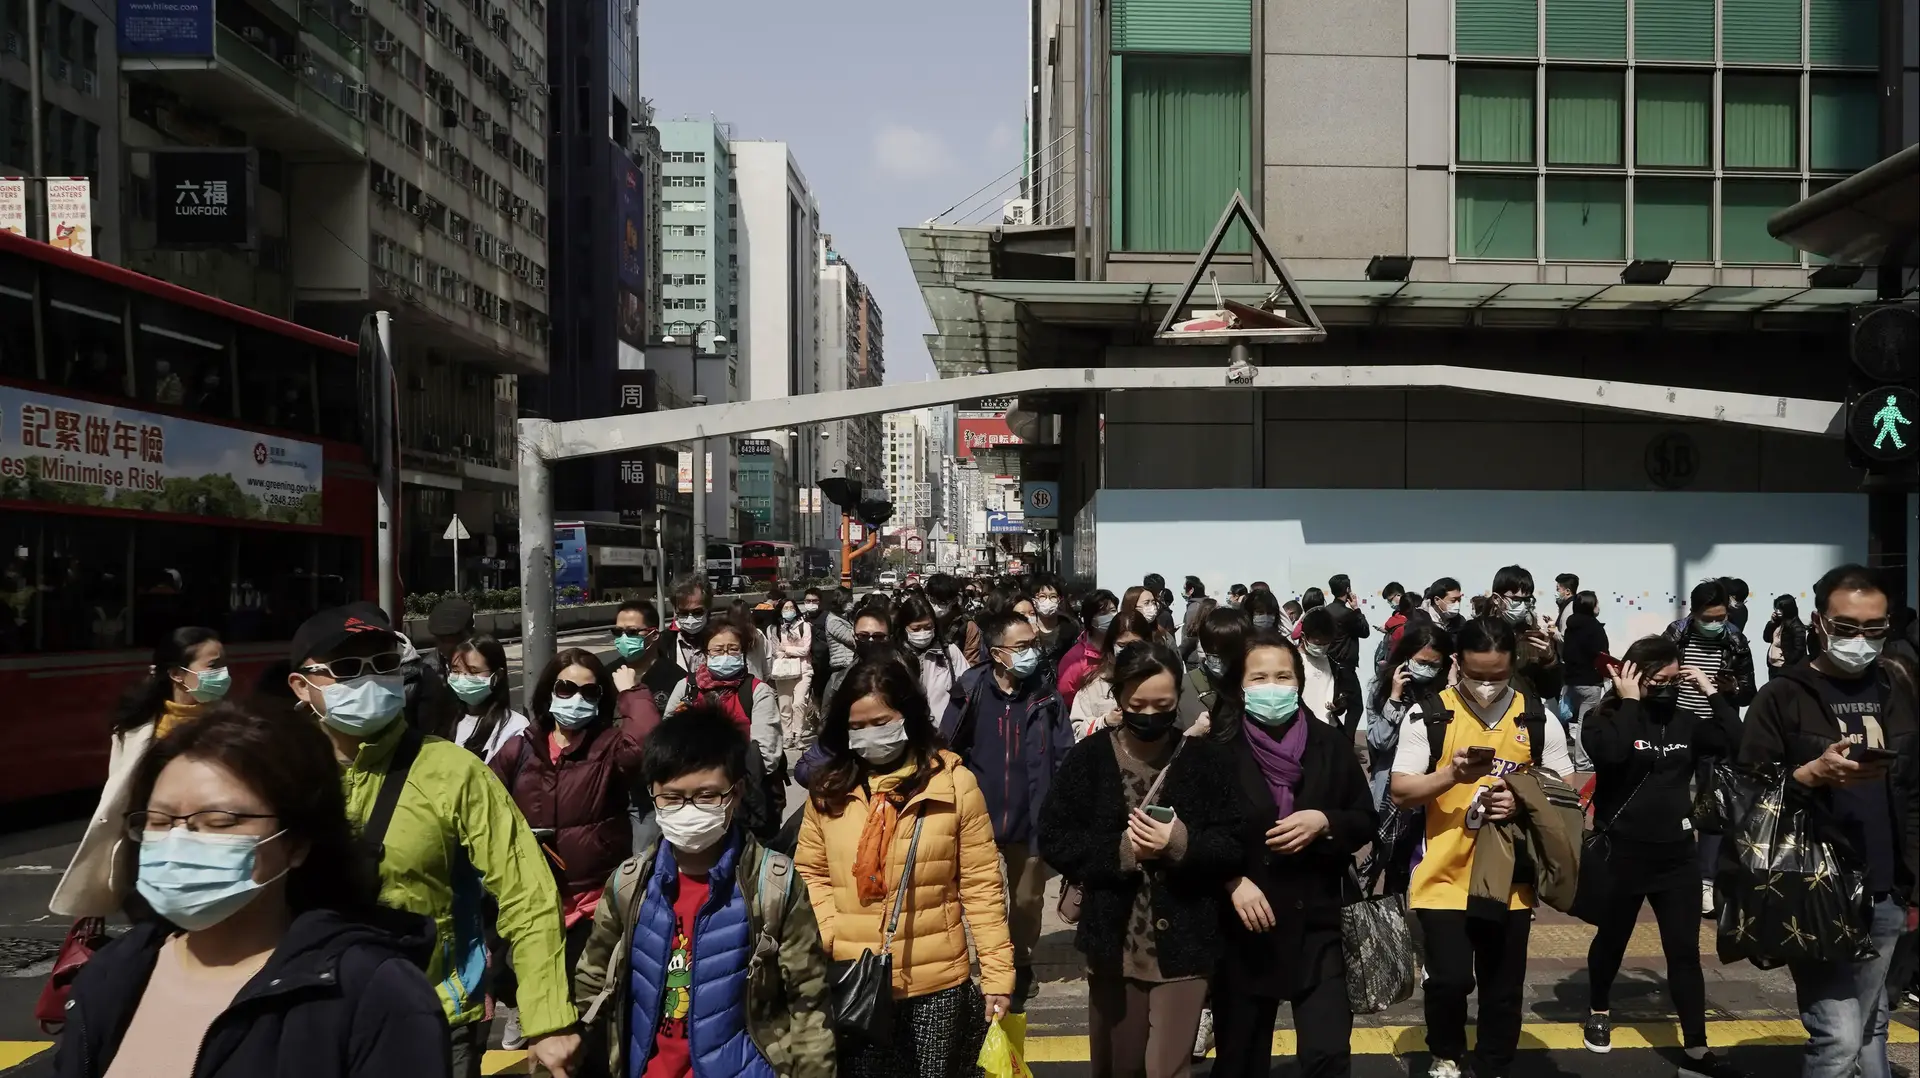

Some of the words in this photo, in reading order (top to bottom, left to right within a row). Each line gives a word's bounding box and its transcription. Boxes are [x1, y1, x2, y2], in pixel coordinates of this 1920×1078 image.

[176, 180, 228, 205] 六福
[175, 206, 227, 216] LUKFOOK
[22, 405, 164, 464] 記緊做年檢
[42, 455, 123, 487] Minimise
[128, 466, 165, 491] Risk
[1849, 733, 1864, 744] OF
